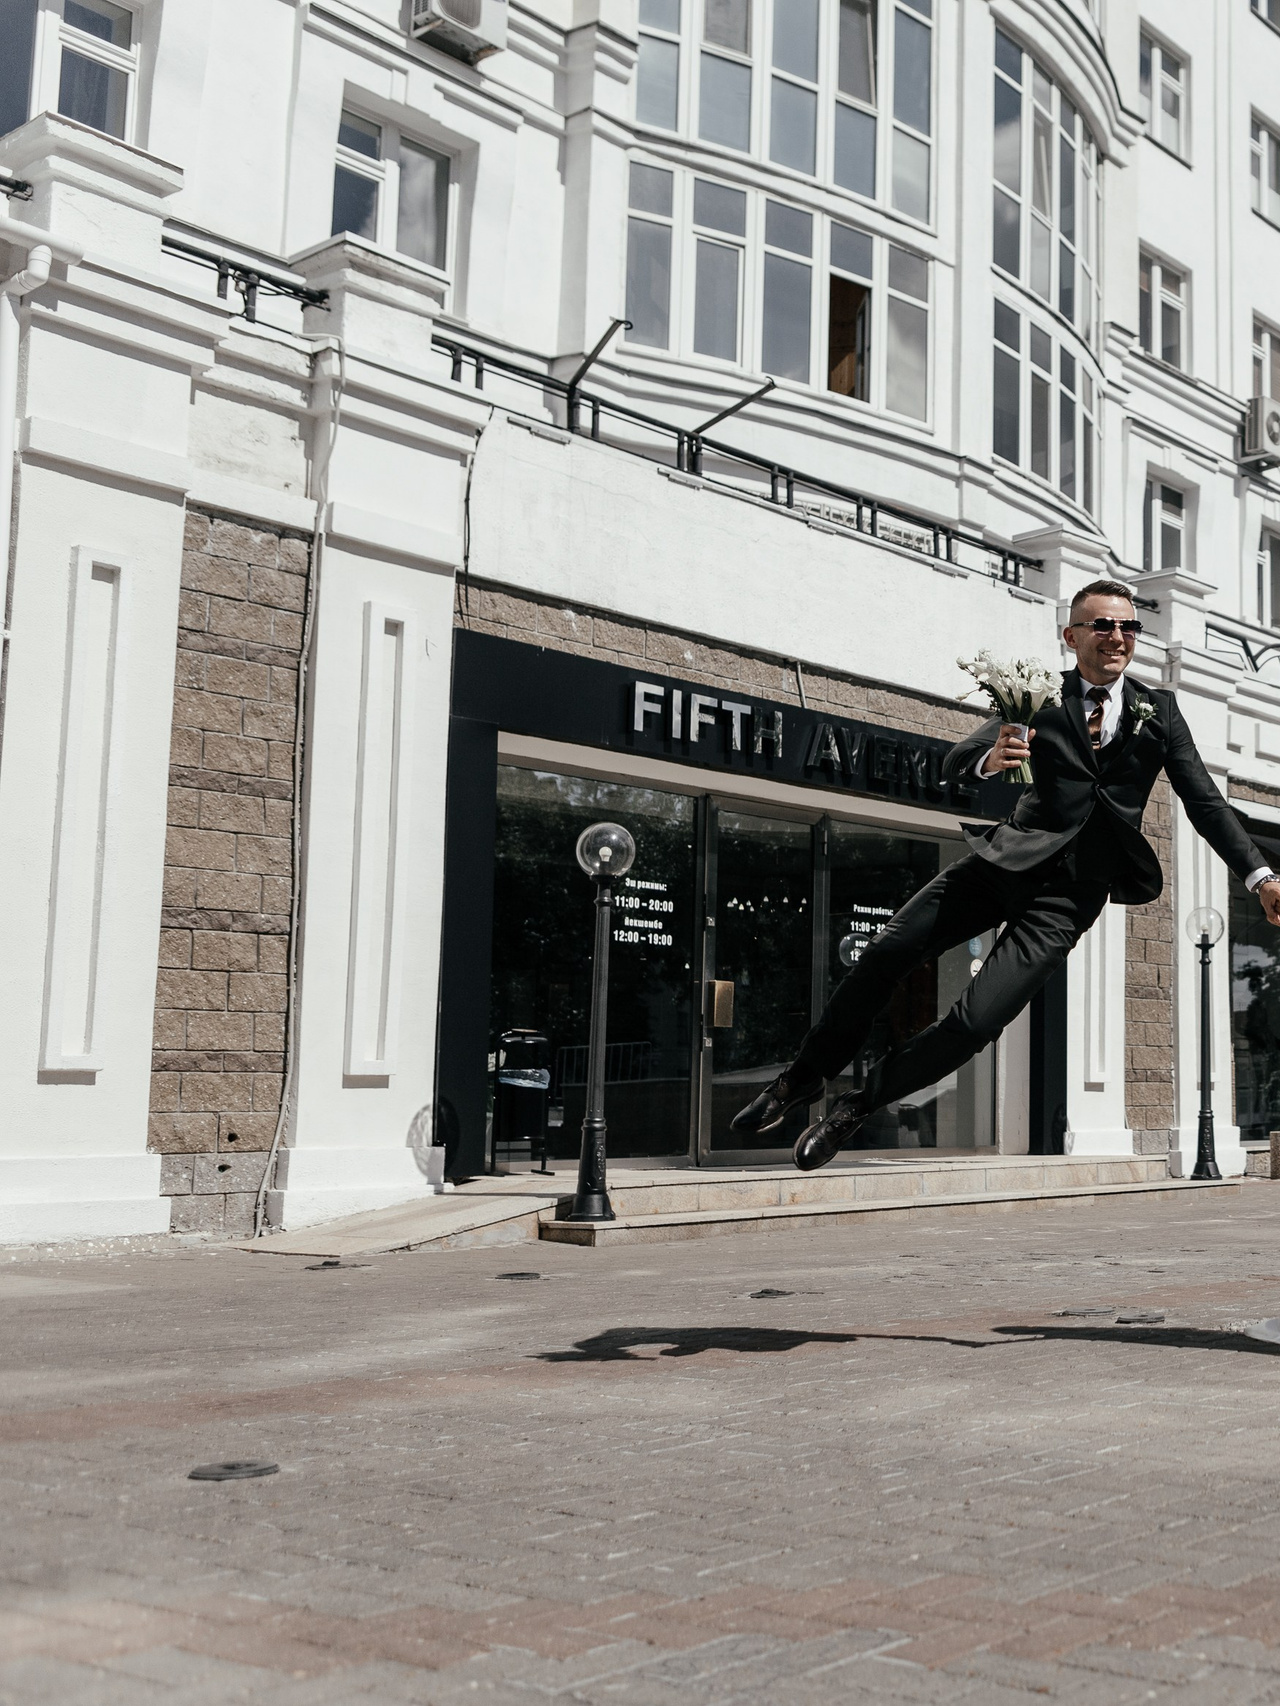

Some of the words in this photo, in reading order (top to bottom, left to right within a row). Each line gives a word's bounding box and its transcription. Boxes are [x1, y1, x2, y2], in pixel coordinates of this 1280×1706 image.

[633, 680, 783, 758] FIFTH
[637, 880, 668, 892] режимы:
[614, 895, 640, 909] 11:00
[648, 898, 674, 913] 20:00
[853, 903, 872, 914] Режим
[872, 906, 894, 916] работы:
[850, 920, 870, 932] 11:00
[613, 929, 639, 943] 12:00
[647, 932, 673, 946] 19:00
